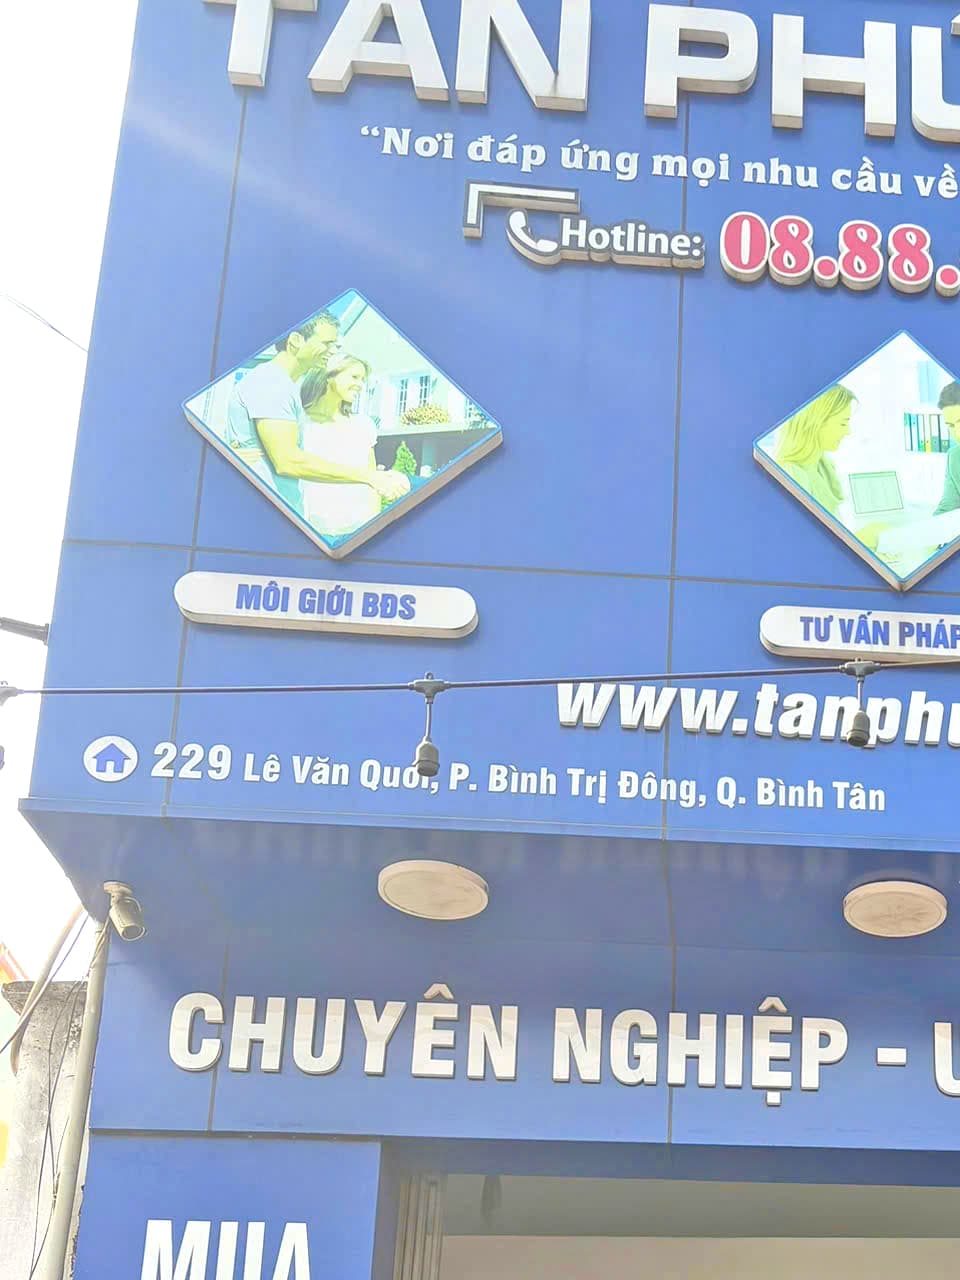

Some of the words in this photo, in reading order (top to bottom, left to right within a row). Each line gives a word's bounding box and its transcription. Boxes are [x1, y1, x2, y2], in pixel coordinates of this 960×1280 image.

[467, 134, 547, 173] đáp
[560, 138, 640, 181] ứng
[652, 151, 731, 188] mọi
[742, 156, 820, 190] nhu
[831, 156, 903, 196] cầu
[913, 163, 960, 199] về
[560, 216, 704, 258] Hotline:
[235, 580, 290, 613] MÔI
[298, 584, 354, 618] GIỚI
[361, 592, 417, 620] BĐS
[799, 614, 836, 642] TƯ
[838, 610, 890, 646] VẤN
[150, 741, 233, 781] 229
[242, 752, 282, 783] Lê
[291, 754, 350, 787] Văn
[448, 761, 478, 792] P.
[487, 763, 557, 796] Bình
[566, 767, 608, 805] Trị
[616, 770, 707, 809] Đông,
[716, 775, 747, 809] Q.
[756, 776, 825, 809] Bình
[831, 780, 887, 812] Tân
[167, 981, 519, 1081] CHUYÊN
[552, 995, 849, 1107] NGHIỆP
[875, 1046, 907, 1068] -
